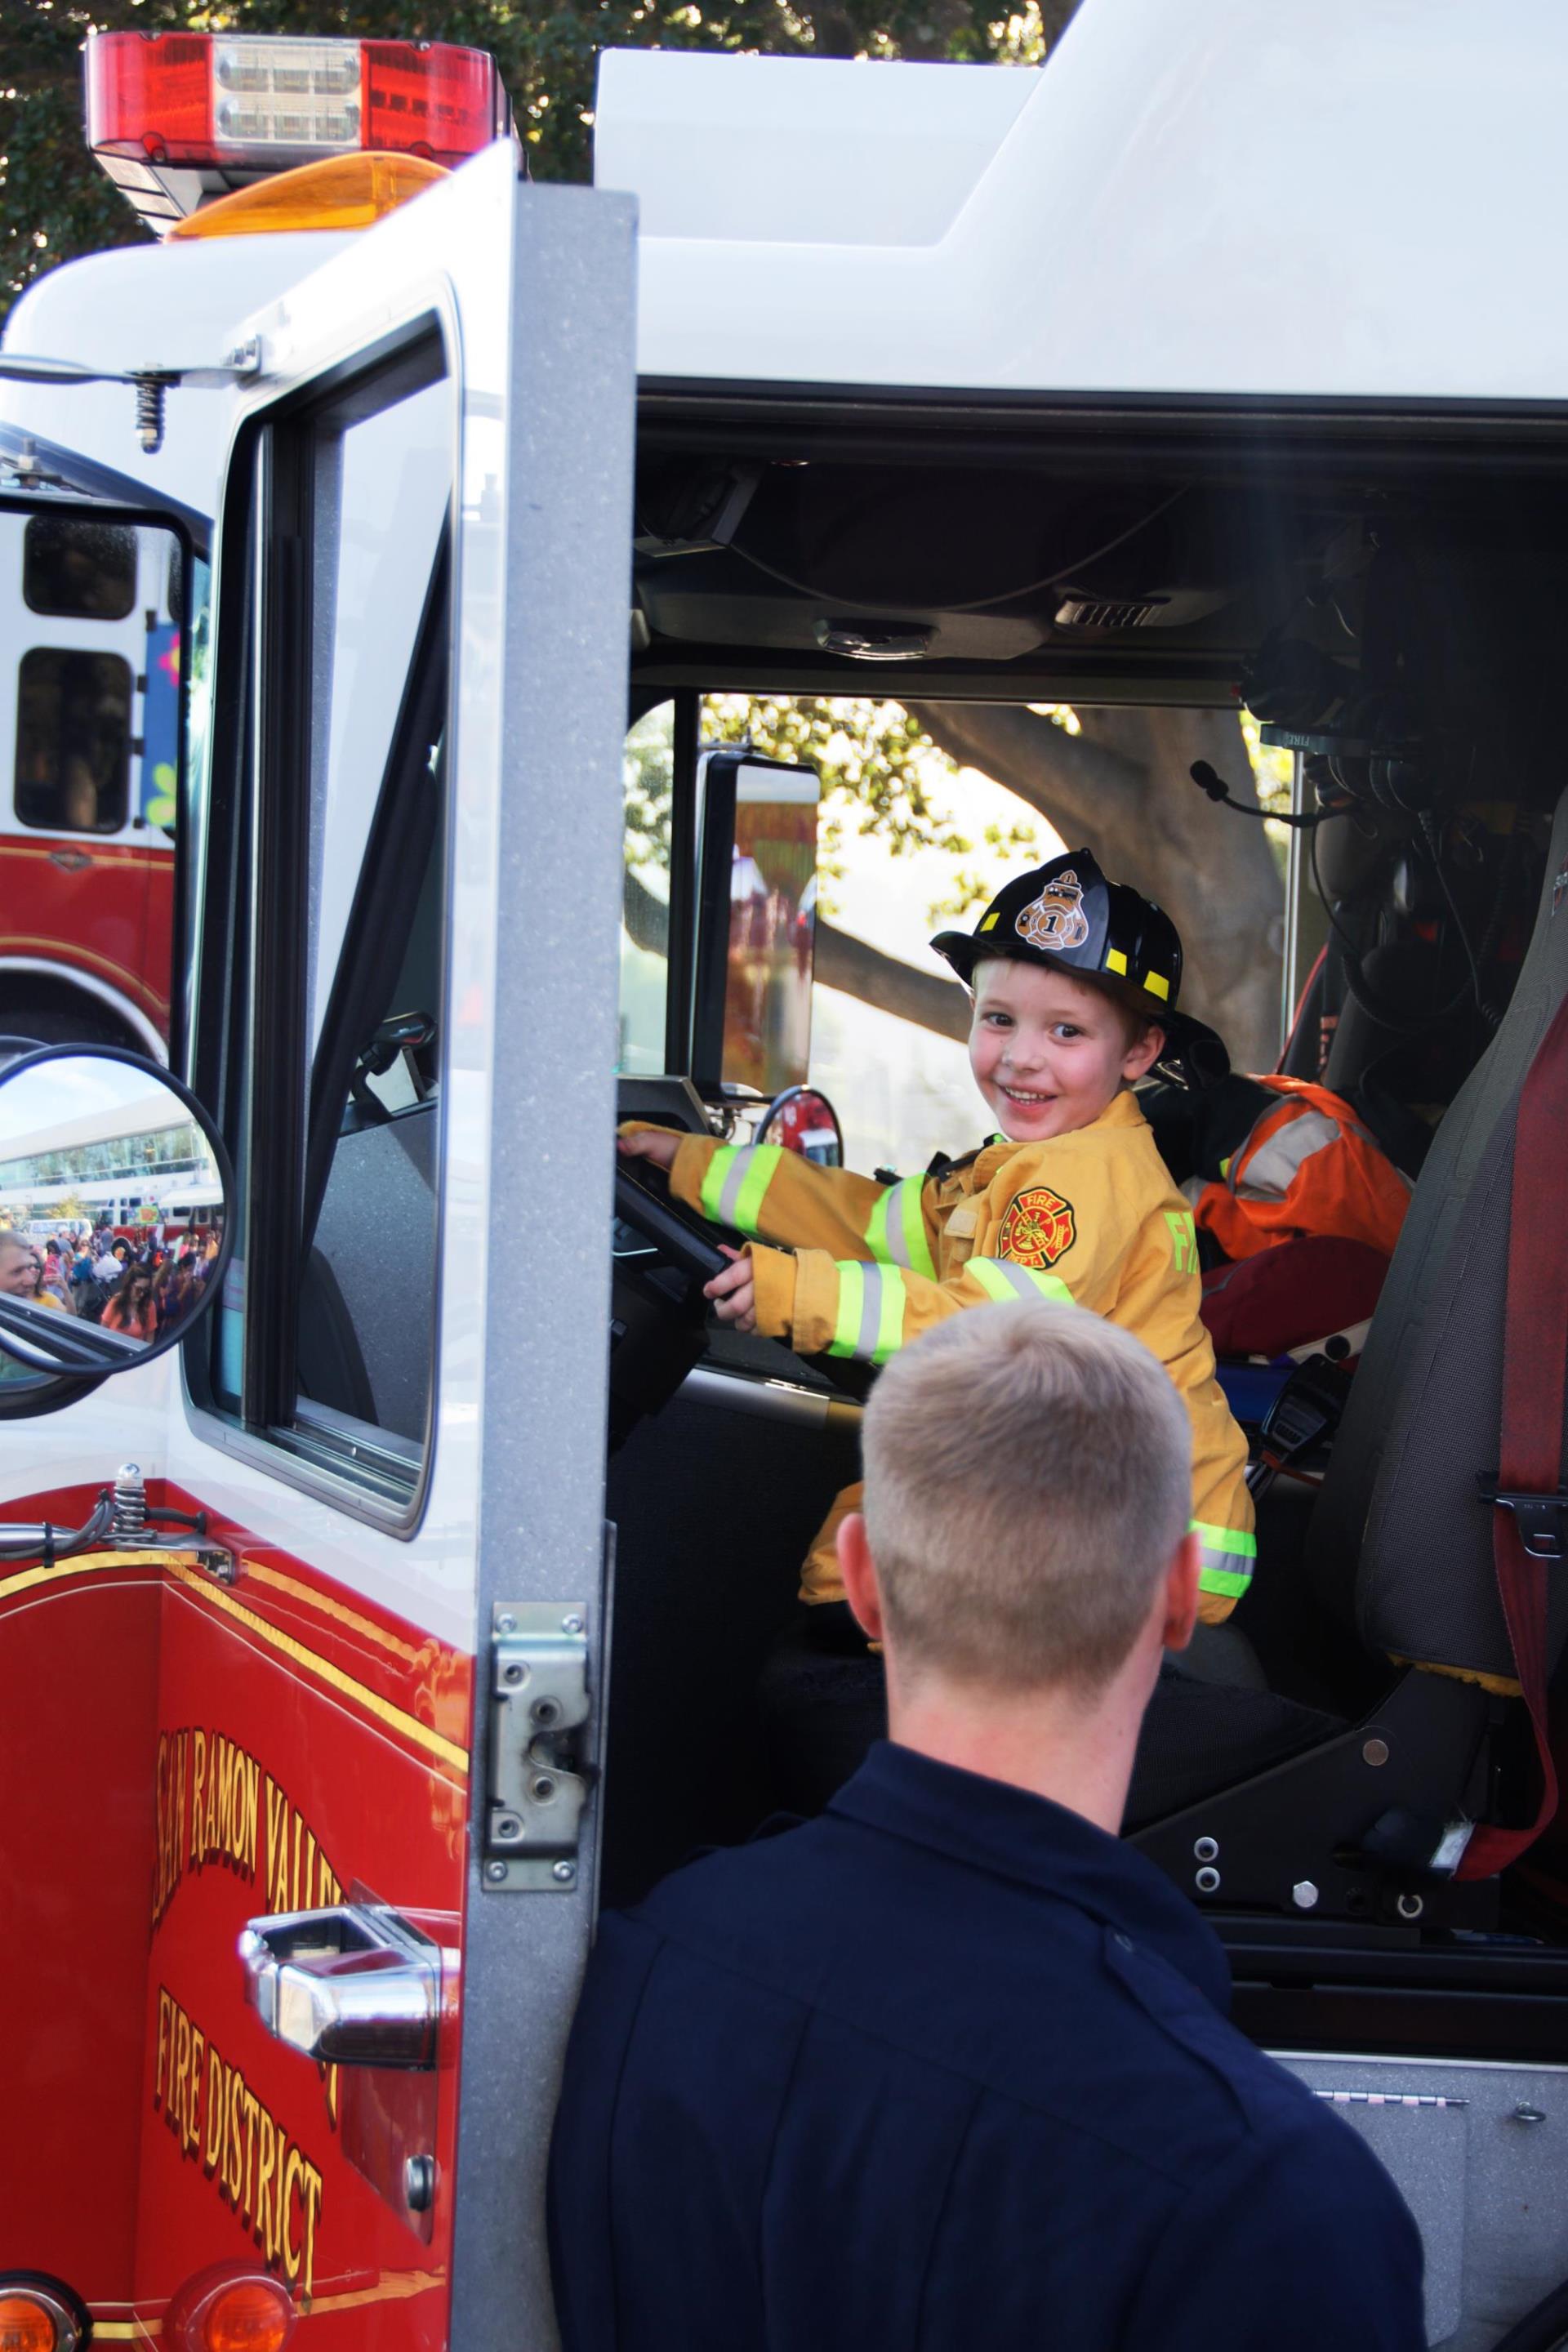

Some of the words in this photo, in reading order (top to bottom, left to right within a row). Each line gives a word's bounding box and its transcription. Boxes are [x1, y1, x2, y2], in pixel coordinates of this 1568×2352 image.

[1043, 915, 1058, 933] 1
[1027, 1194, 1056, 1209] FIRE
[153, 1730, 188, 1926] SAN
[191, 1729, 261, 1875] RAMON
[157, 1989, 205, 2153] FIRE
[206, 2042, 323, 2303] DISTRICT
